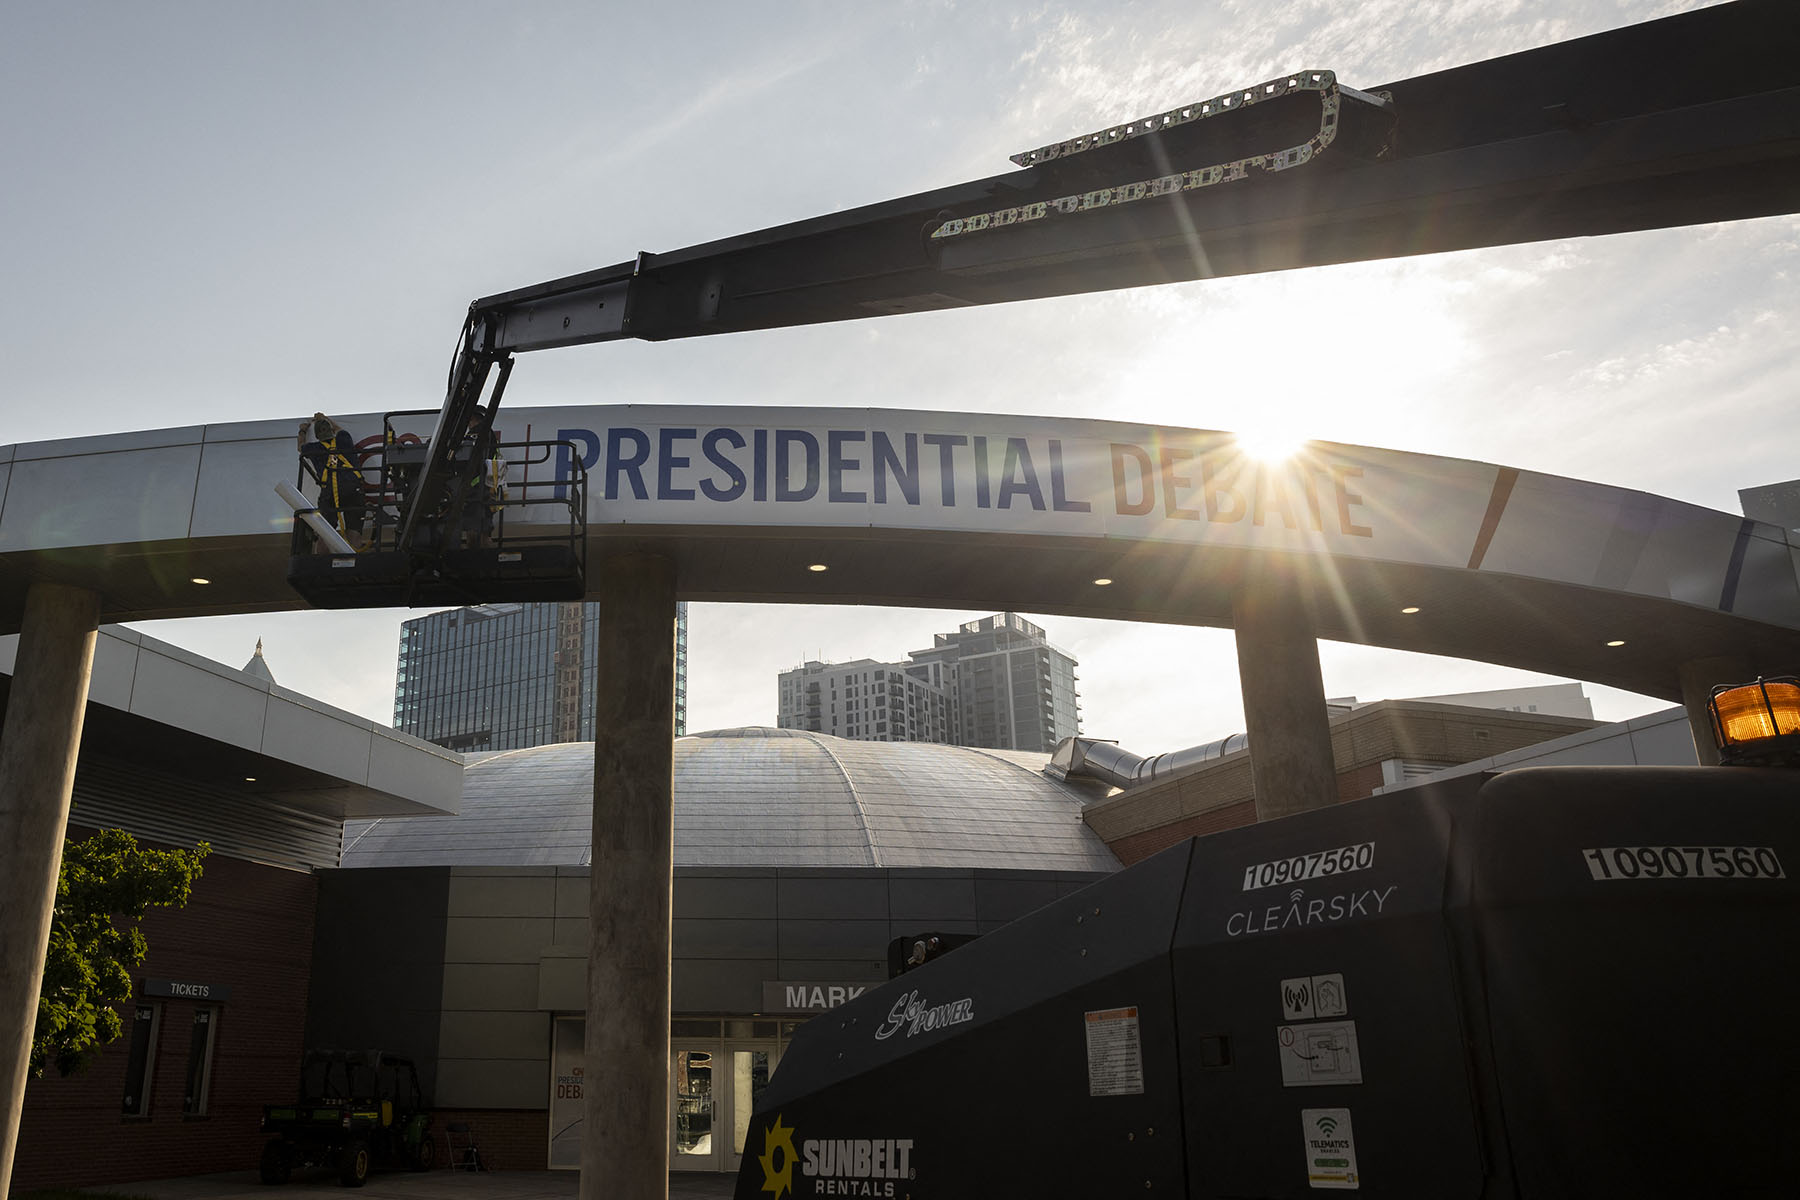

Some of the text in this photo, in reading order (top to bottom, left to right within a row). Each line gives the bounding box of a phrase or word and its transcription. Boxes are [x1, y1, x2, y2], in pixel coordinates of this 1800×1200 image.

[554, 427, 1092, 513] PRESIDENTIAL
[1110, 442, 1374, 538] DEBATE
[1247, 843, 1373, 889] 10907560
[1589, 847, 1781, 878] 10907560
[1226, 886, 1394, 937] CLEARSKY
[170, 983, 210, 997] TICKETS
[802, 1138, 914, 1179] SUNBELT
[1310, 1140, 1349, 1148] TELEMATICS
[815, 1179, 895, 1197] RENTALS
